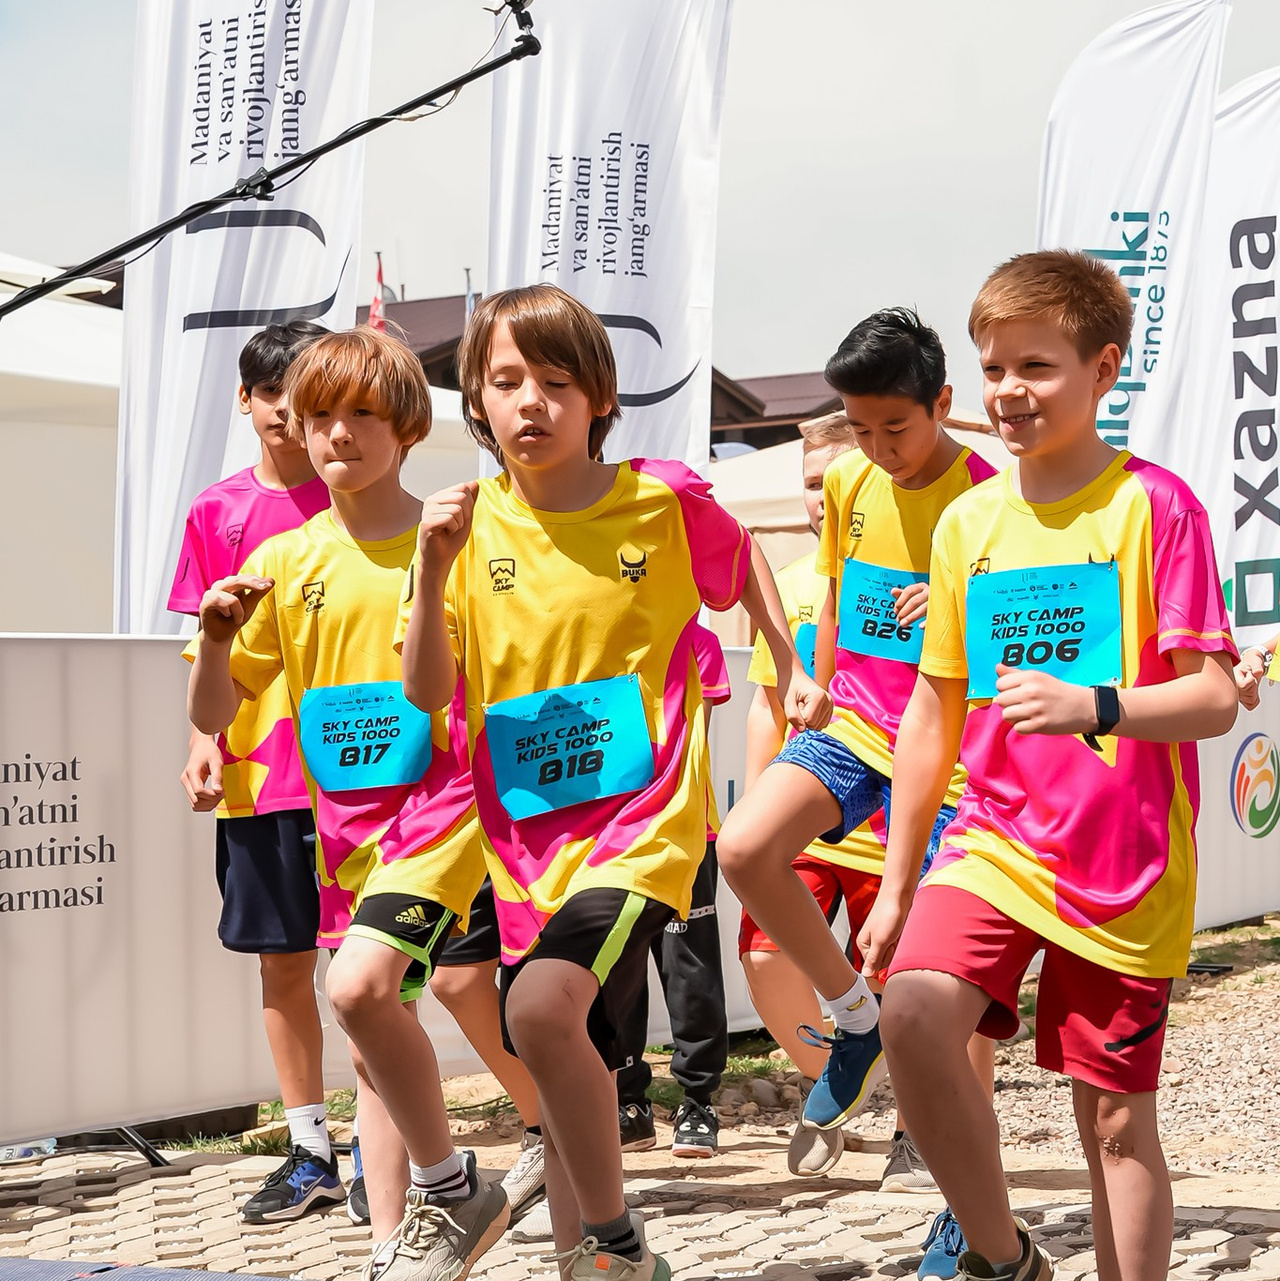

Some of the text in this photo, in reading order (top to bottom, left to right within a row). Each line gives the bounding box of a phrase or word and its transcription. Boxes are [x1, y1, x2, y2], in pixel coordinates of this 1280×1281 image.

[190, 18, 217, 166] Madaniyat
[218, 130, 232, 163] va
[541, 153, 567, 272] Madaniyat
[596, 131, 622, 275] rivojlantirish
[573, 249, 588, 273] va
[1144, 284, 1165, 373] since
[621, 568, 647, 578] BUKA
[855, 604, 880, 618] KIDS
[857, 594, 895, 609] SKY CA
[861, 619, 914, 642] 826
[991, 607, 1084, 627] SKY CAMP
[990, 621, 1086, 641] KIDS 1000
[1001, 638, 1083, 667] 806
[322, 716, 400, 733] SKY CAMP
[323, 728, 401, 745] KIDS 1000
[515, 719, 610, 751] SKY CAMP
[339, 742, 392, 767] 817
[517, 732, 613, 764] KIDS 1000
[0, 753, 82, 790] niyat
[538, 749, 604, 786] 818
